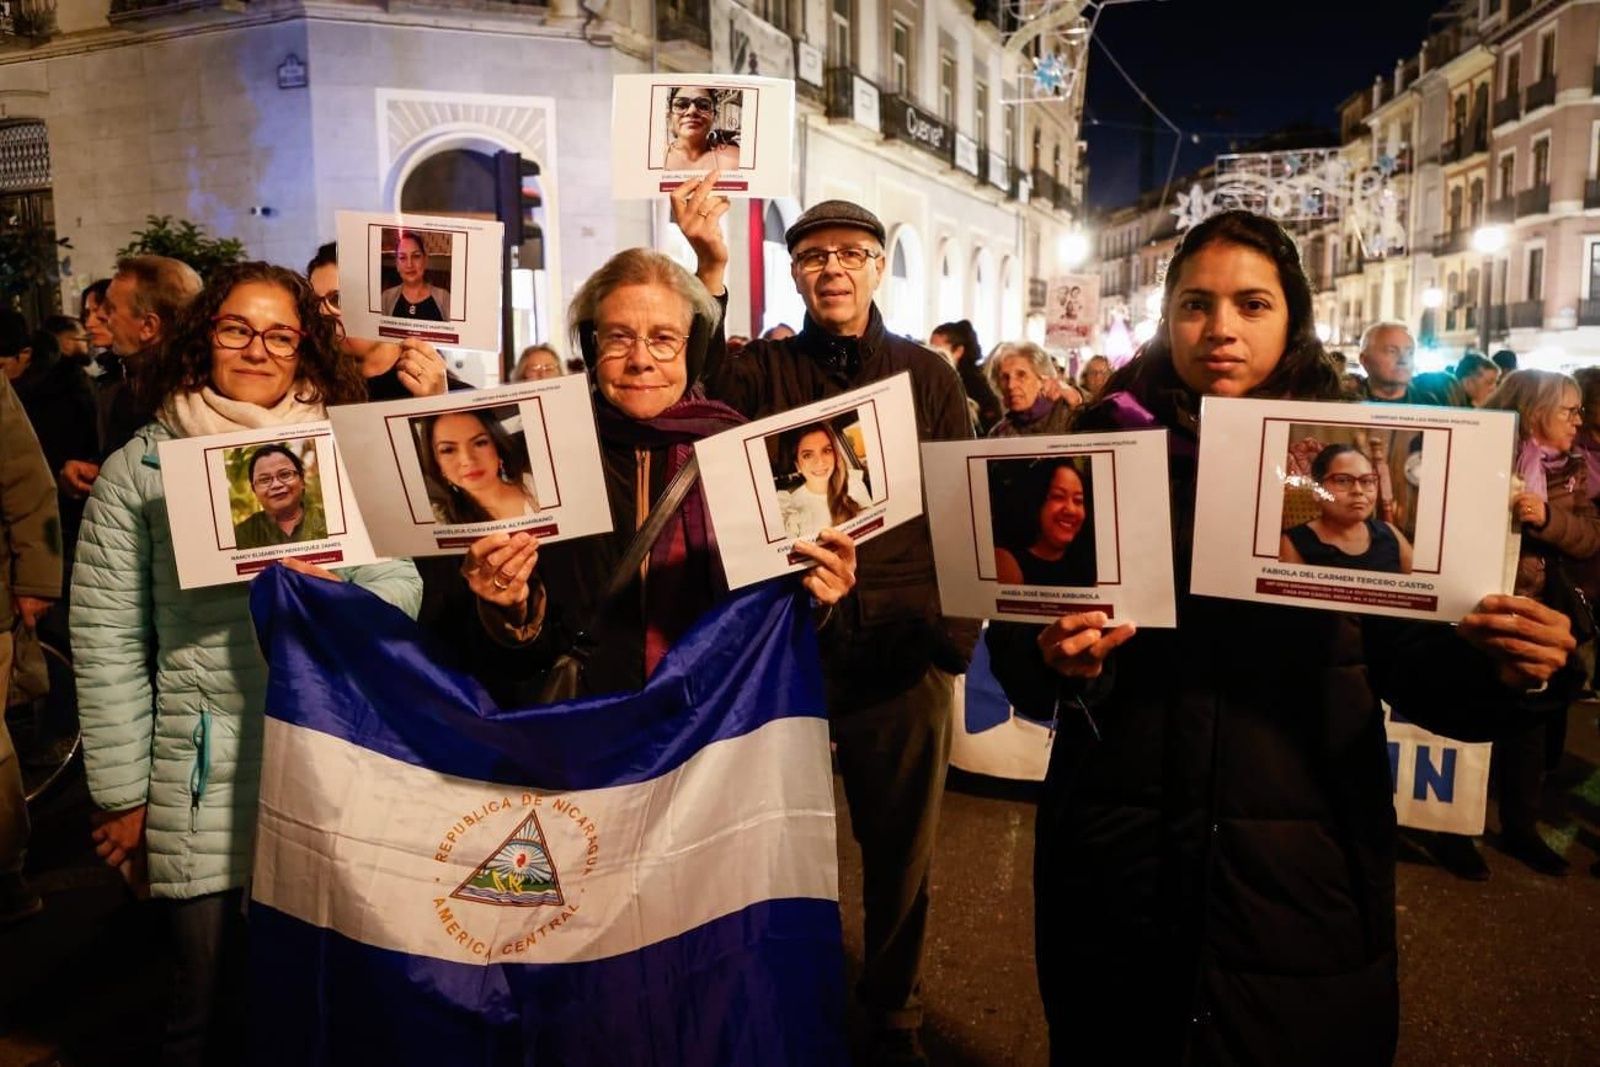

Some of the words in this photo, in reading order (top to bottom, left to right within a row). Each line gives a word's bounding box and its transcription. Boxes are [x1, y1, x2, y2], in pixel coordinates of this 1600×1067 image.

[231, 553, 251, 561] NANCY
[251, 549, 284, 559] ELIZABETH
[1261, 567, 1298, 577] FABIOLA
[1299, 571, 1314, 579] DEL
[1317, 572, 1354, 582] CARMEN
[1357, 576, 1397, 587] TERCERO
[1398, 580, 1435, 590] CASTRO
[435, 797, 512, 863] REPUBLICA
[521, 793, 543, 806] DE
[552, 799, 599, 875] NICARAGUA
[433, 897, 492, 963] AMERICA
[502, 905, 579, 955] CENTRAL
